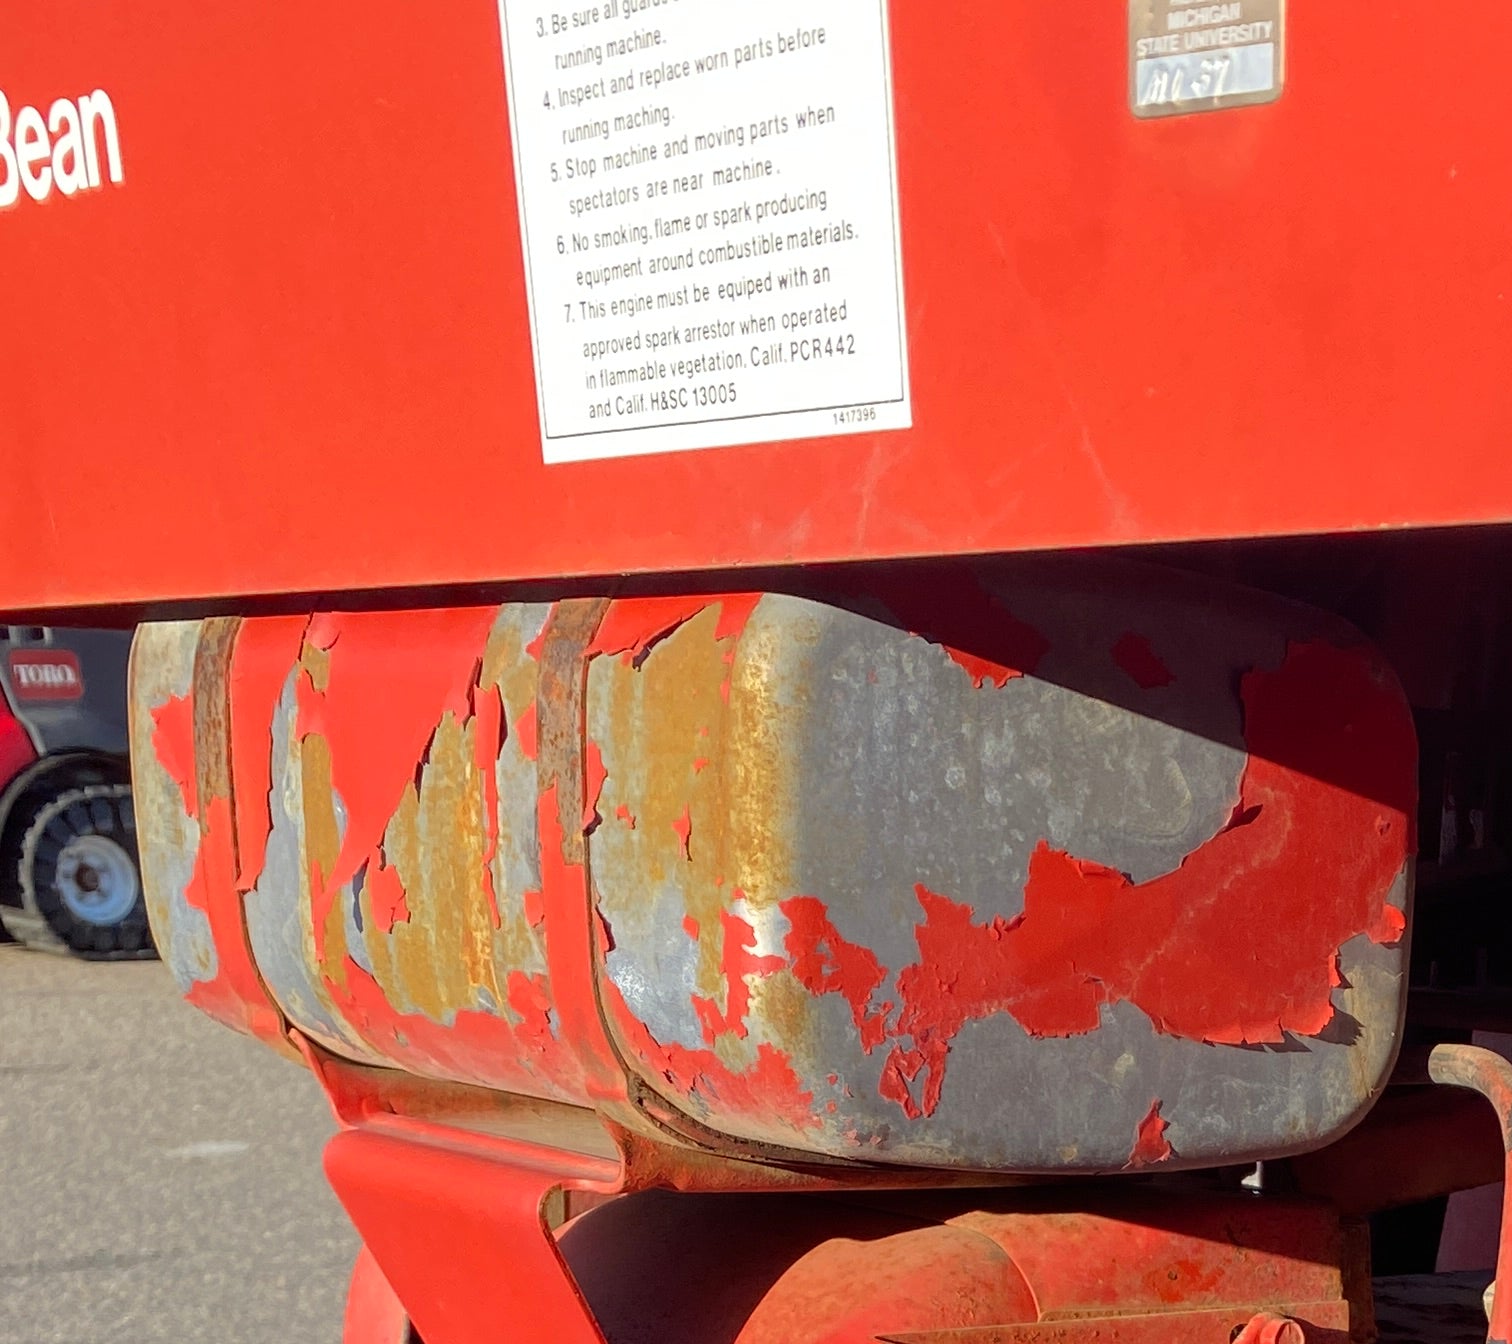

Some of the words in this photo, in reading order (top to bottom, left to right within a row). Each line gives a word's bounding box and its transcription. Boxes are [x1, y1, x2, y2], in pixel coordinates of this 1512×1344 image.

[536, 17, 548, 38] 3.
[551, 14, 568, 35] Be
[572, 7, 599, 27] sure
[603, 0, 619, 19] all
[622, 0, 668, 19] gua
[1167, 2, 1242, 31] MICHIGAN
[554, 44, 602, 70] running
[606, 27, 667, 58] machine.
[1137, 34, 1180, 57] STATE
[1184, 21, 1273, 50] UNIVERSITY
[543, 90, 556, 110] 4.
[558, 77, 606, 107] Inspect
[610, 69, 635, 94] and
[639, 60, 690, 89] replace
[694, 51, 729, 74] worn
[734, 37, 774, 69] parts
[777, 27, 826, 54] before
[550, 162, 562, 183] 5.
[565, 158, 597, 179] Stop
[603, 143, 657, 172] machine
[664, 134, 689, 159] and
[695, 125, 745, 151] moving
[750, 114, 789, 145] parts
[796, 105, 836, 129] when
[562, 118, 610, 145] running
[569, 186, 640, 218] spectators
[646, 179, 668, 199] are
[673, 172, 704, 194] near
[556, 235, 569, 255] 6.
[572, 232, 590, 253] No
[654, 215, 692, 239] flame
[695, 212, 709, 230] or
[713, 201, 752, 229] spark
[755, 188, 828, 224] producing
[576, 257, 643, 289] equipment
[649, 248, 694, 274] around
[699, 232, 784, 266] combustible
[786, 219, 860, 251] materials.
[563, 303, 576, 323] 7.
[578, 301, 606, 321] This
[610, 293, 653, 318] engine
[657, 284, 689, 309] must
[693, 283, 710, 303] be
[717, 271, 773, 302] equiped
[777, 266, 809, 291] with
[813, 265, 831, 285] an
[582, 329, 641, 361] approved
[645, 325, 681, 352] spark
[684, 319, 736, 343] arrestor
[740, 314, 776, 336] when
[781, 299, 848, 332] operated
[585, 370, 597, 390] in
[600, 360, 667, 388] flammable
[750, 342, 788, 367] Calif.
[790, 334, 856, 362] PCR442
[588, 400, 612, 419] and
[615, 393, 648, 415] Calif.
[650, 387, 688, 412] H&SC
[692, 382, 737, 407] 13005
[833, 407, 877, 425] 1417396
[13, 663, 76, 685] TORO
